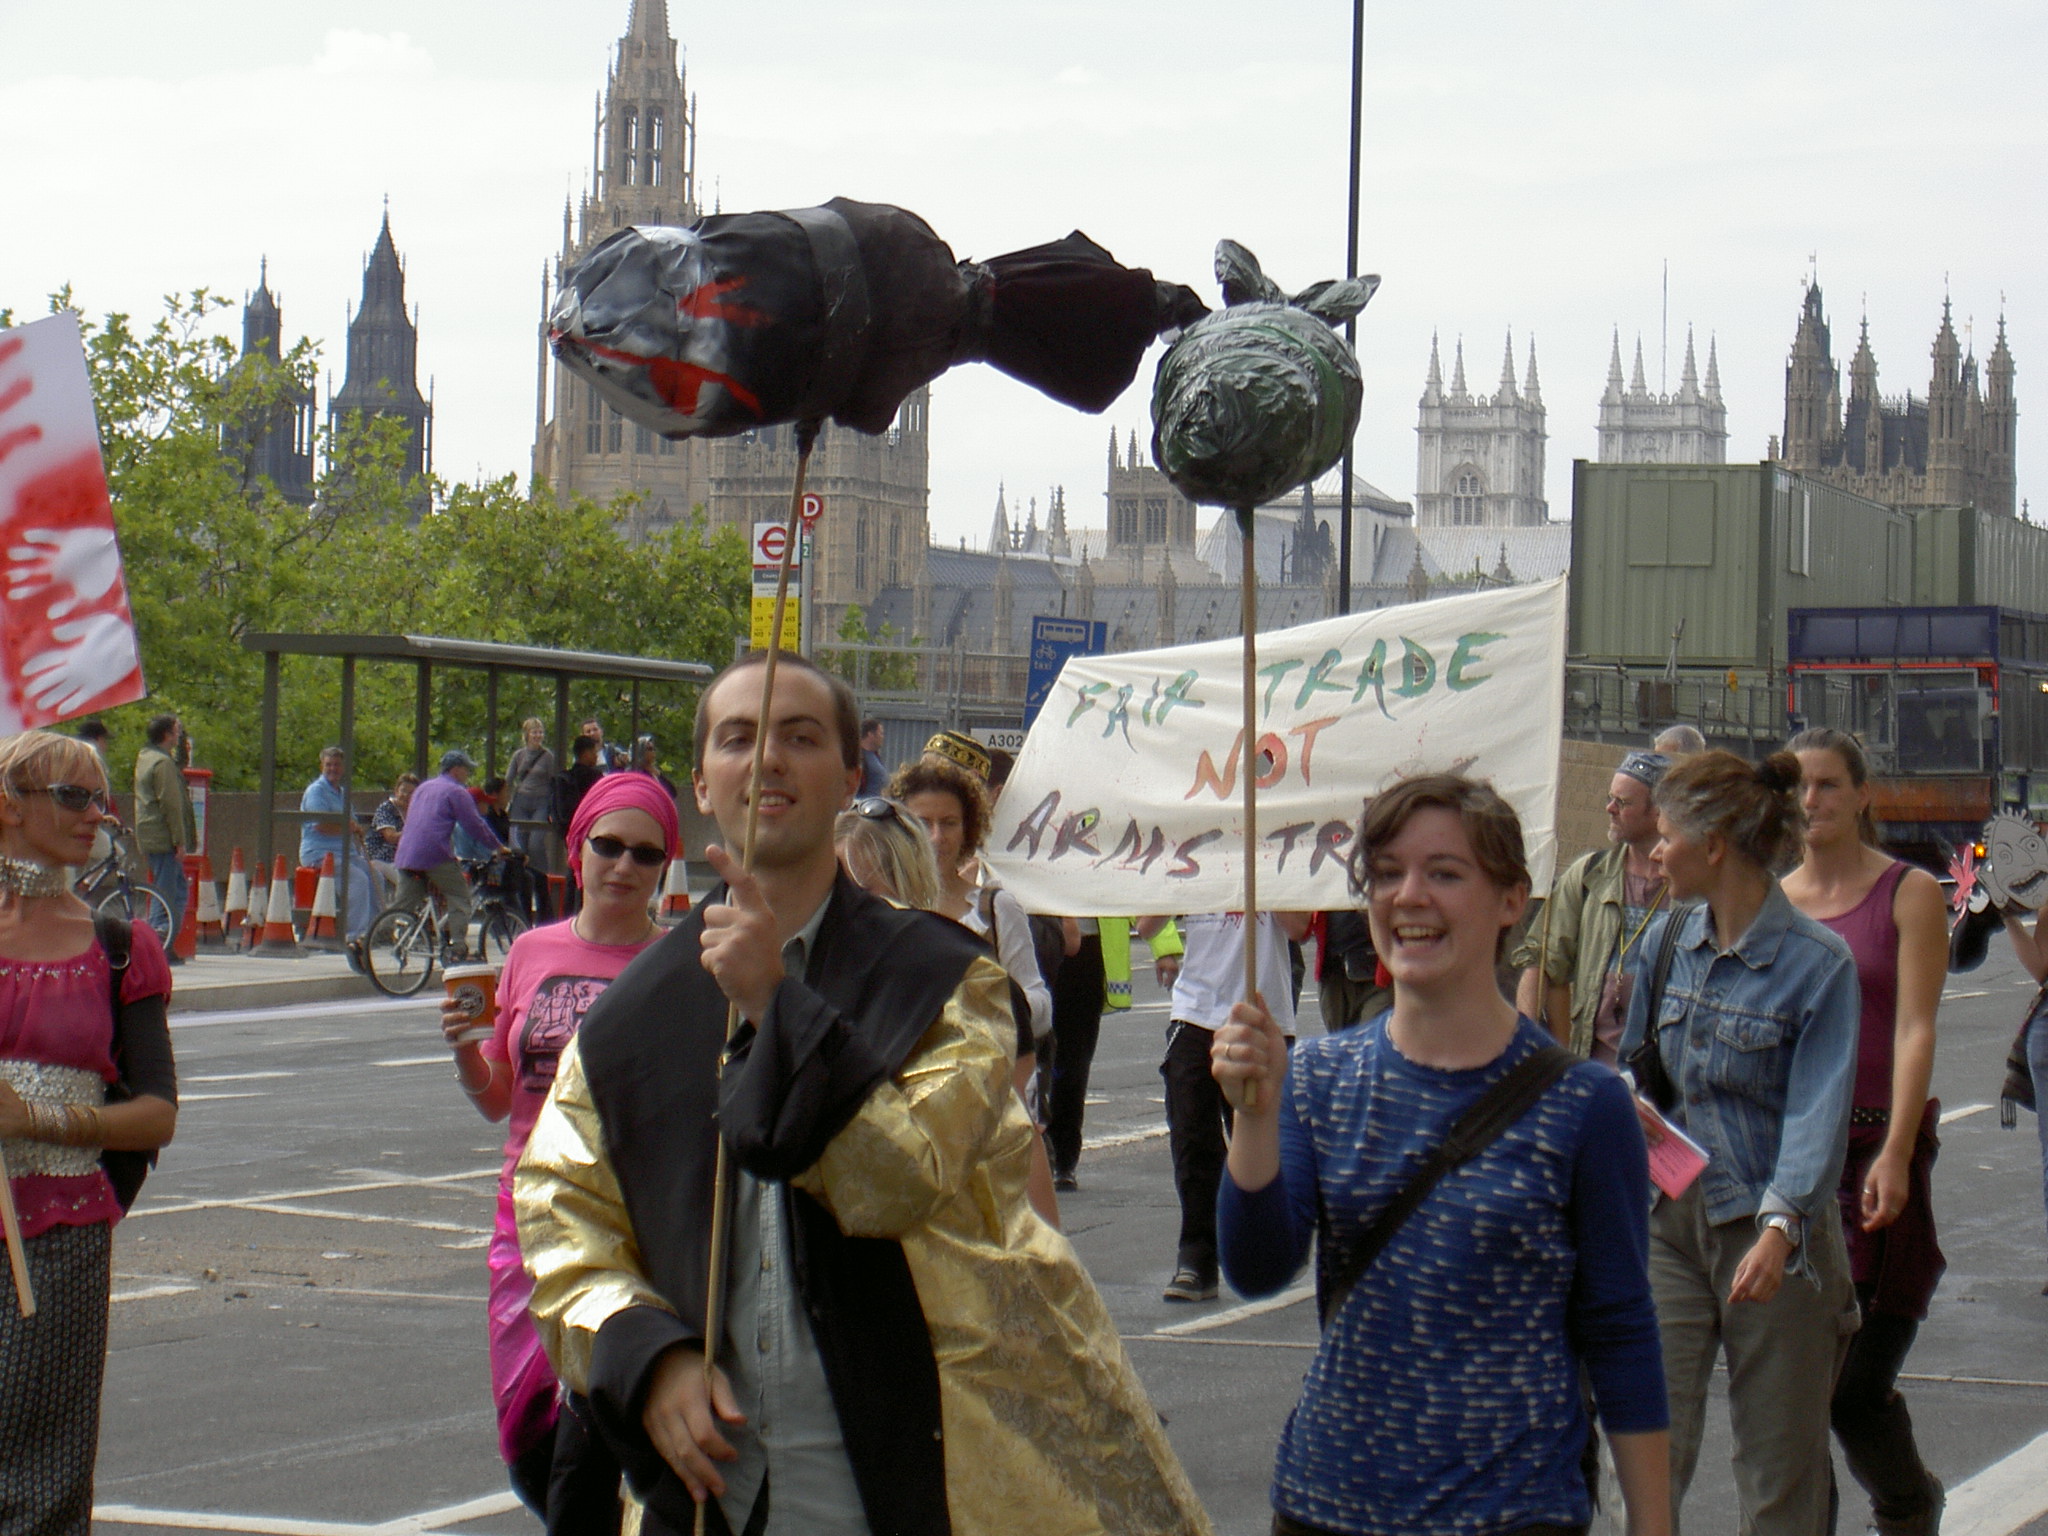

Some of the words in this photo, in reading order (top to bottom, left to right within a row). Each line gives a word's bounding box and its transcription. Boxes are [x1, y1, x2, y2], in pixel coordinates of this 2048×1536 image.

[803, 497, 820, 517] D
[803, 545, 810, 557] 2
[1033, 661, 1052, 670] taxi
[1066, 669, 1206, 753] FAIR
[1257, 631, 1509, 721] TRADE
[988, 734, 1024, 747] A302
[1184, 716, 1342, 801] NOT
[1006, 789, 1224, 879] ARMS
